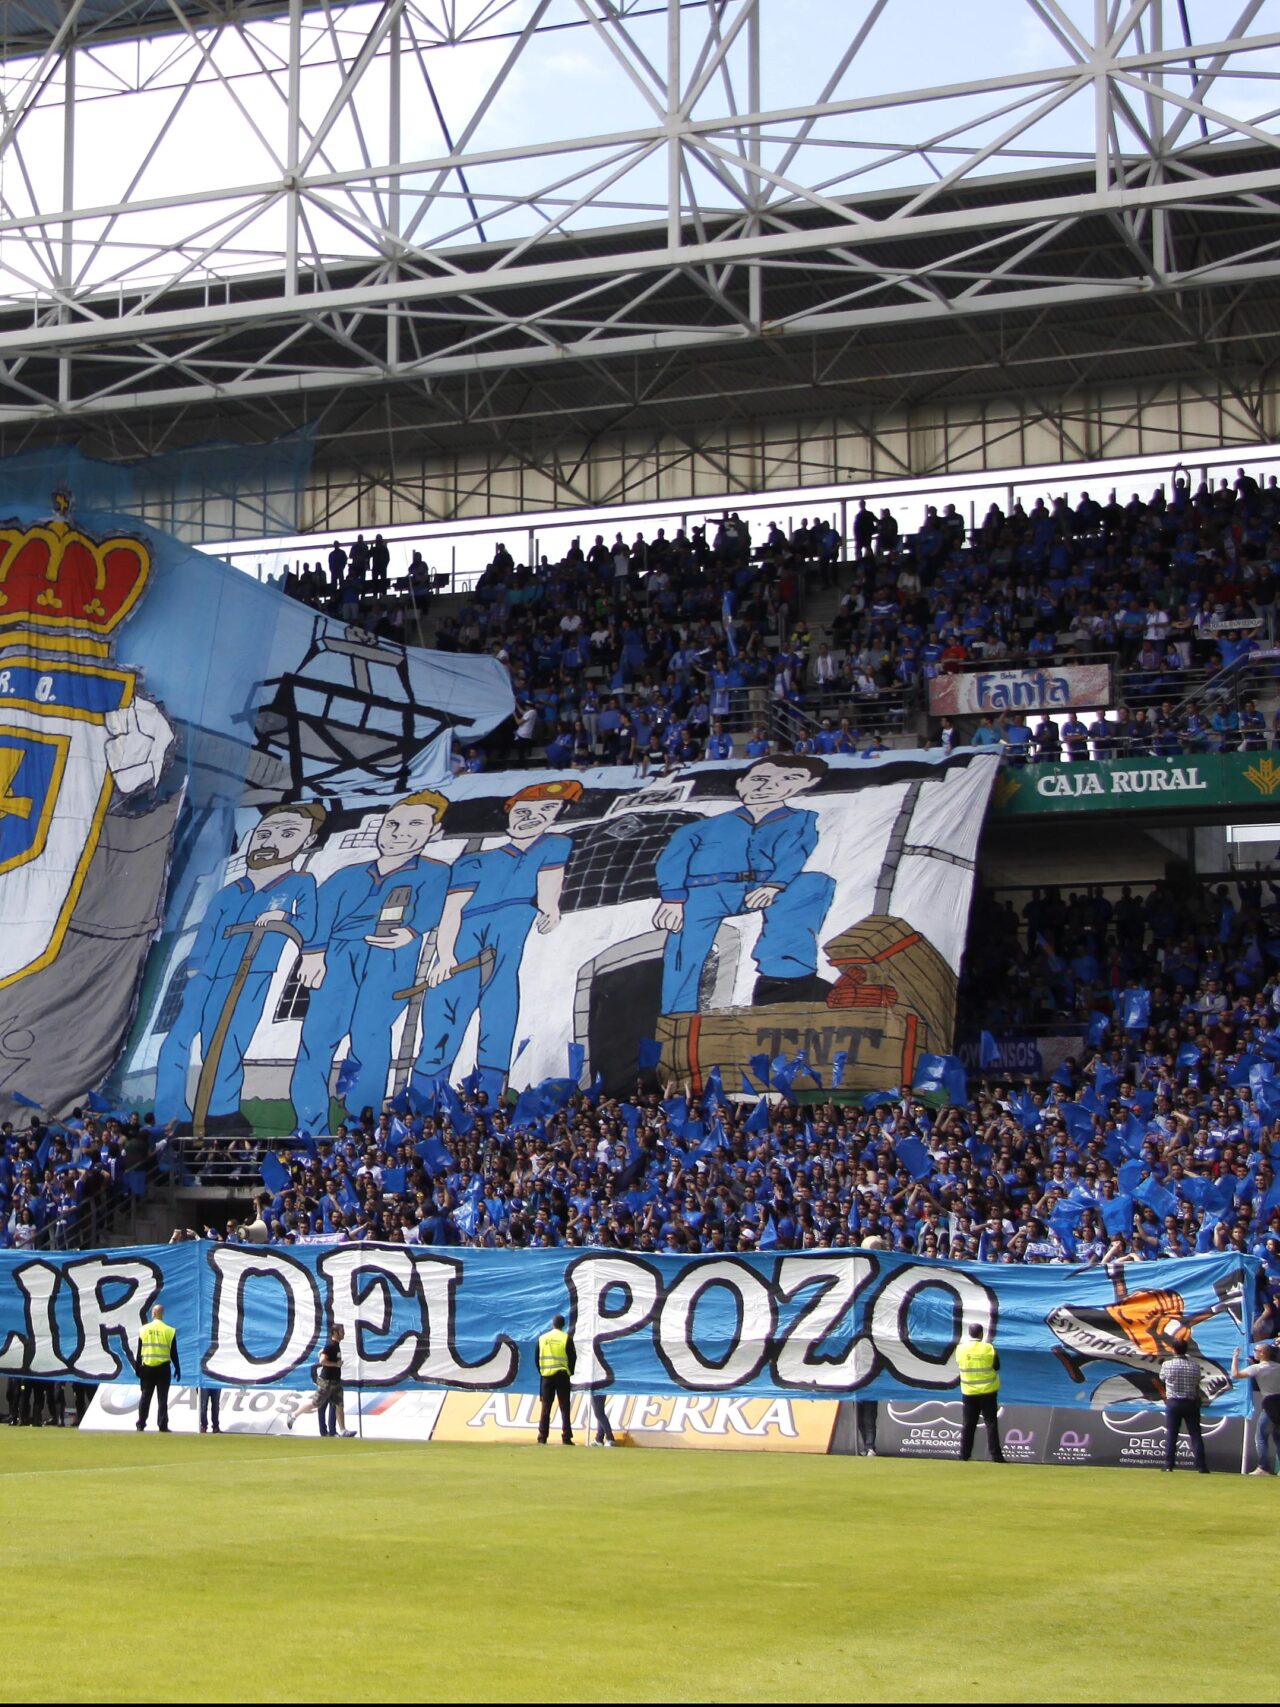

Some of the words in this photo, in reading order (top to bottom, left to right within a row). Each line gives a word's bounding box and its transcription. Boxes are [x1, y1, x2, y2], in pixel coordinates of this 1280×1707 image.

[976, 671, 1070, 710] Fanta
[1037, 771, 1104, 798] CAJA
[1110, 767, 1207, 794] RURAL
[757, 1026, 883, 1066] TNT
[201, 1242, 518, 1391] DEL
[564, 1252, 999, 1391] POZO
[466, 1393, 799, 1437] ALMERKA
[902, 1438, 961, 1447] GASTRONOM
[1121, 1448, 1195, 1458] GASTRONMÍA
[1129, 1438, 1190, 1450] DELOA
